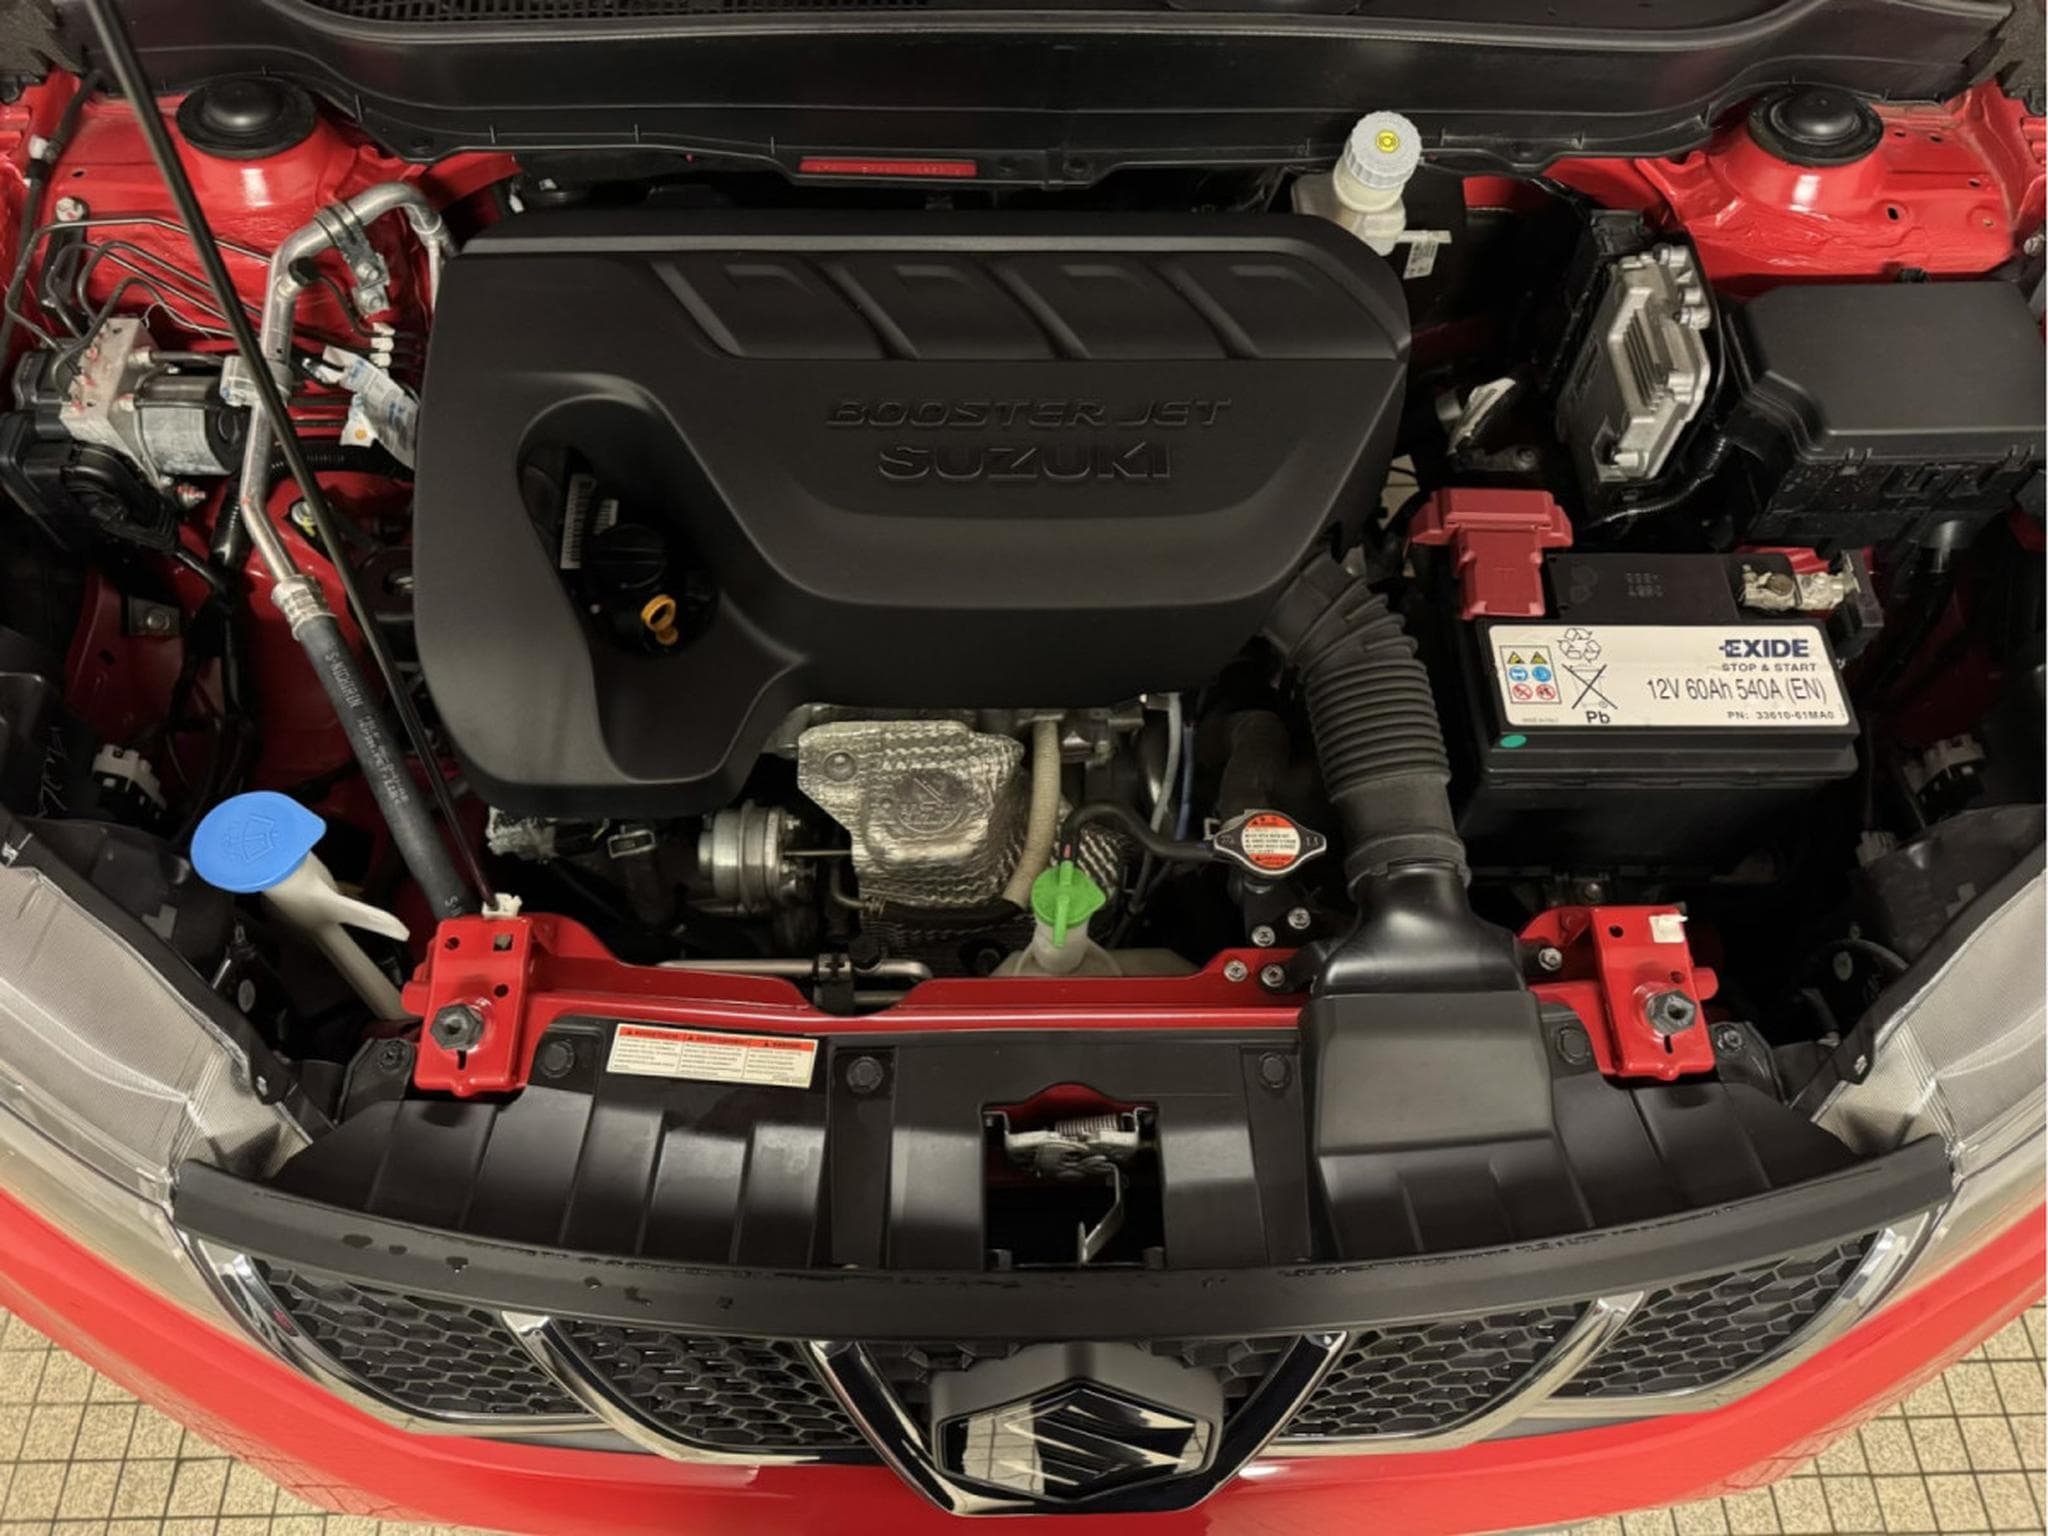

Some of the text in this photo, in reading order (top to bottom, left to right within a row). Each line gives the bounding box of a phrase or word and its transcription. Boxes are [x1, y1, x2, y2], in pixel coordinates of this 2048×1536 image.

[826, 398, 1233, 428] BOOSTER JET
[877, 440, 1173, 481] SUZUKI
[1720, 638, 1810, 658] EXIDE
[1722, 663, 1817, 673] STOP & START
[1646, 677, 1827, 705] 12V 60Ah 540A (EN)
[1585, 710, 1611, 725] Pb
[1727, 711, 1750, 720] PN:
